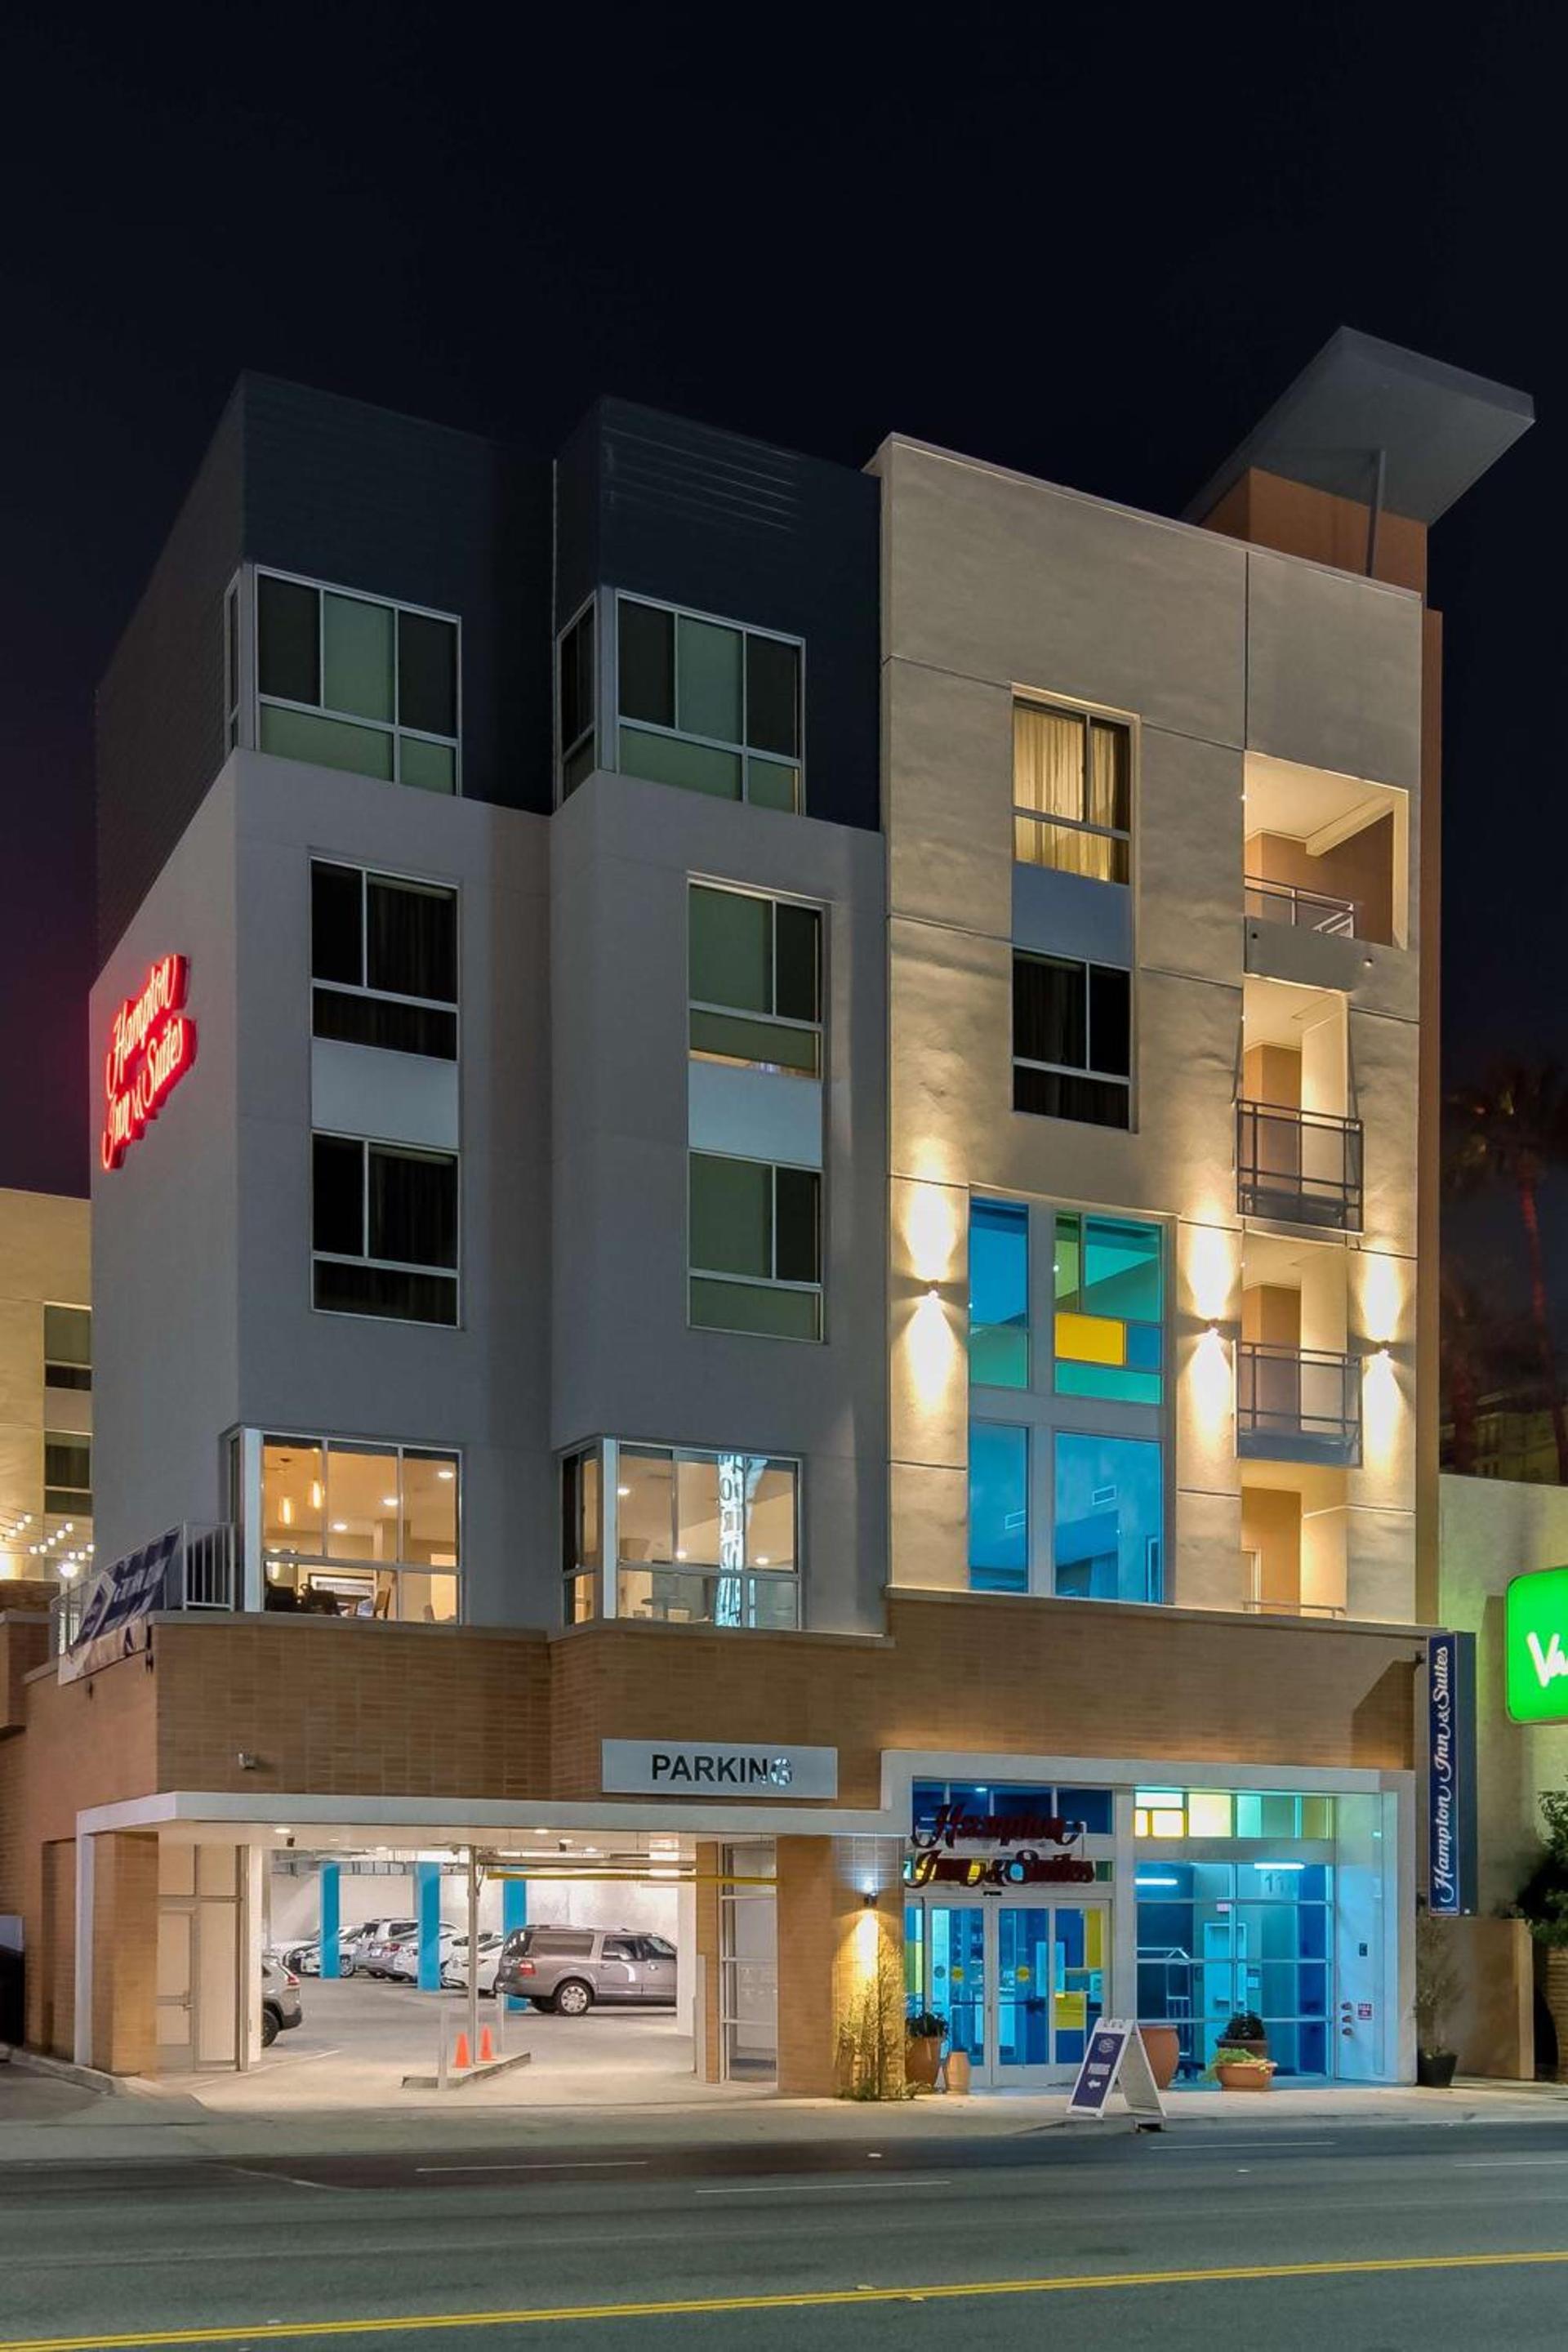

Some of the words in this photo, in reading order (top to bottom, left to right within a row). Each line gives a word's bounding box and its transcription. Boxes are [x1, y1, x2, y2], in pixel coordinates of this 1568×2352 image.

[105, 952, 188, 1101] Hampton
[143, 1018, 193, 1109] Suites
[1432, 1645, 1450, 1709] Suites
[651, 1754, 793, 1786] PARKING
[1433, 1722, 1452, 1784] Inn
[1432, 1784, 1454, 1904] Hampton
